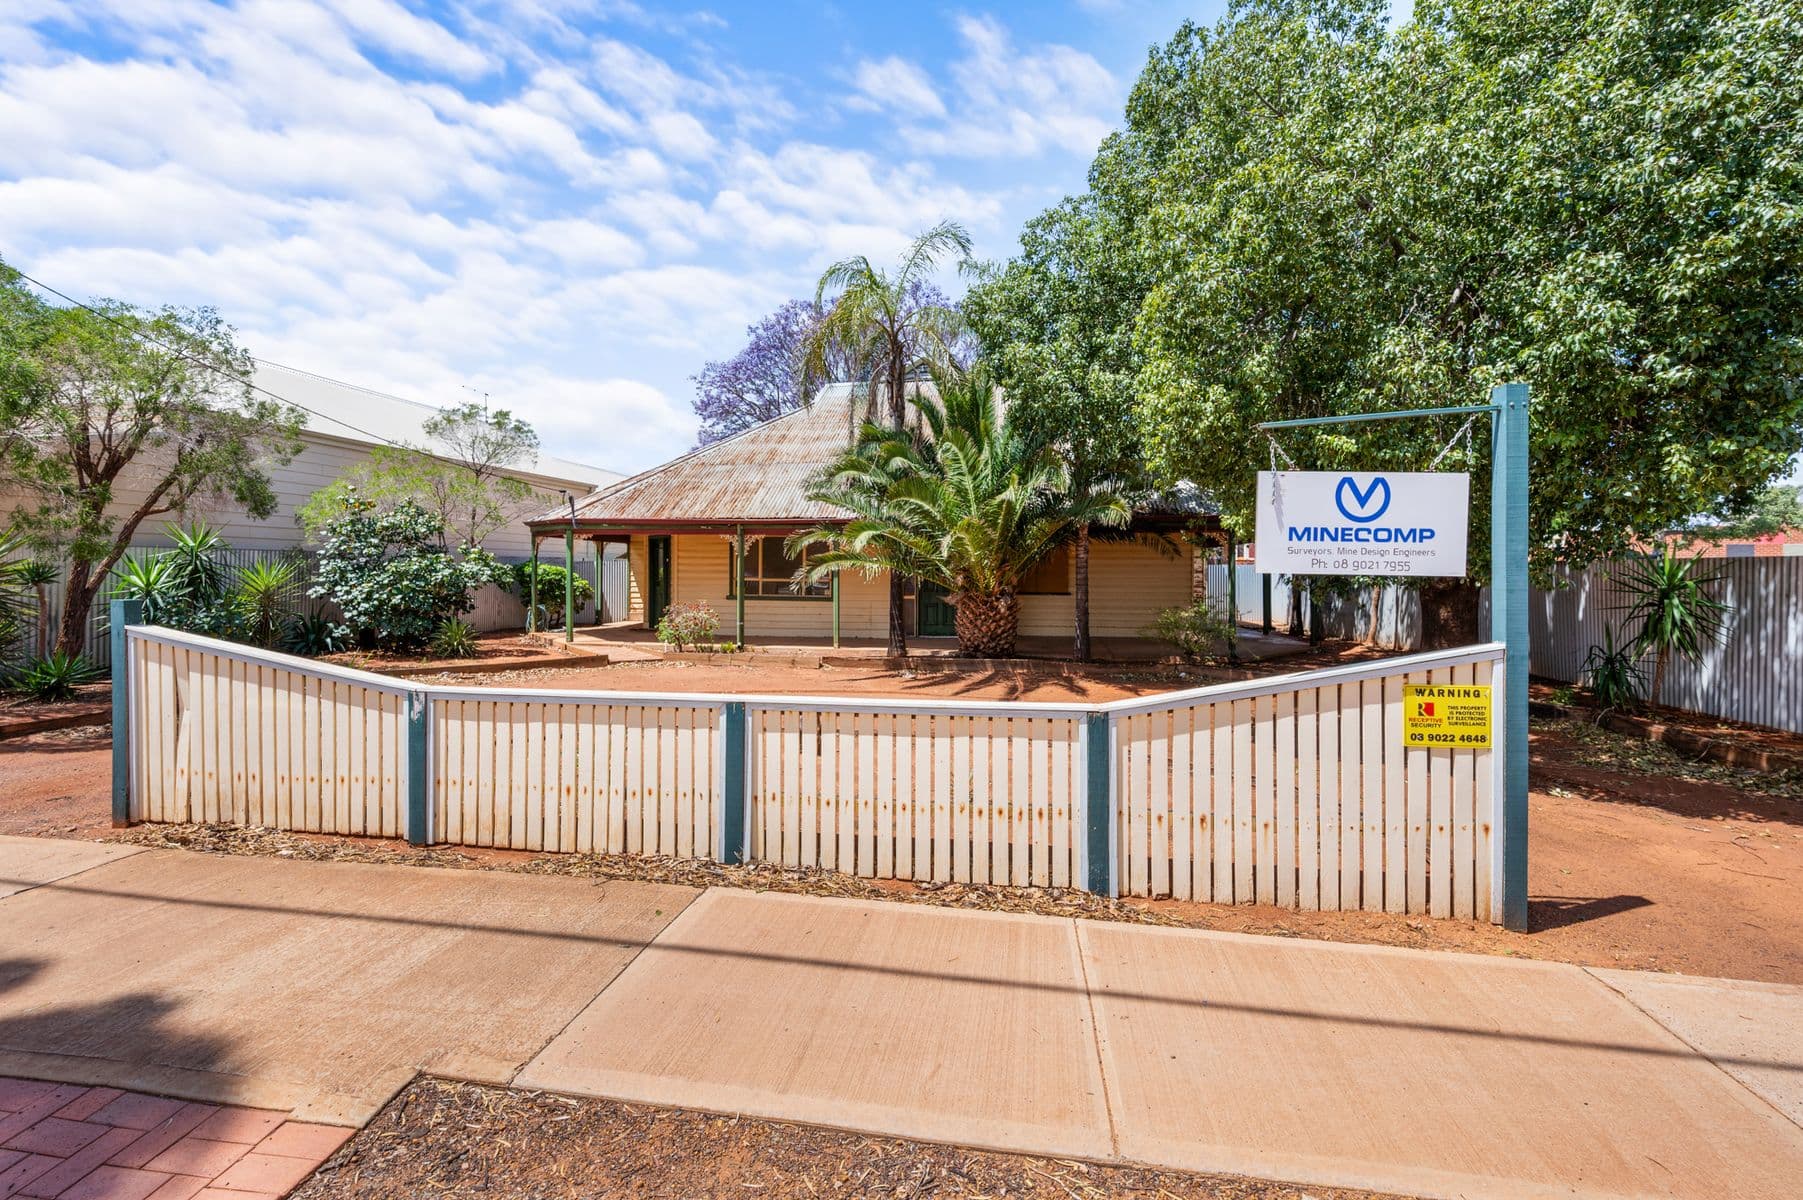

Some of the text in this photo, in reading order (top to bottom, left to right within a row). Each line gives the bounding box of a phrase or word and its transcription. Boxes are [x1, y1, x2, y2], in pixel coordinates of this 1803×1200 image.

[1288, 526, 1436, 543] MINECOMP
[1337, 547, 1358, 556] Mine
[1360, 548, 1390, 557] Design
[1393, 548, 1436, 558] Engineers
[1311, 558, 1411, 572] Ph: 08 9021 7955
[1415, 688, 1481, 698] WARNING
[1428, 734, 1455, 742] 9022
